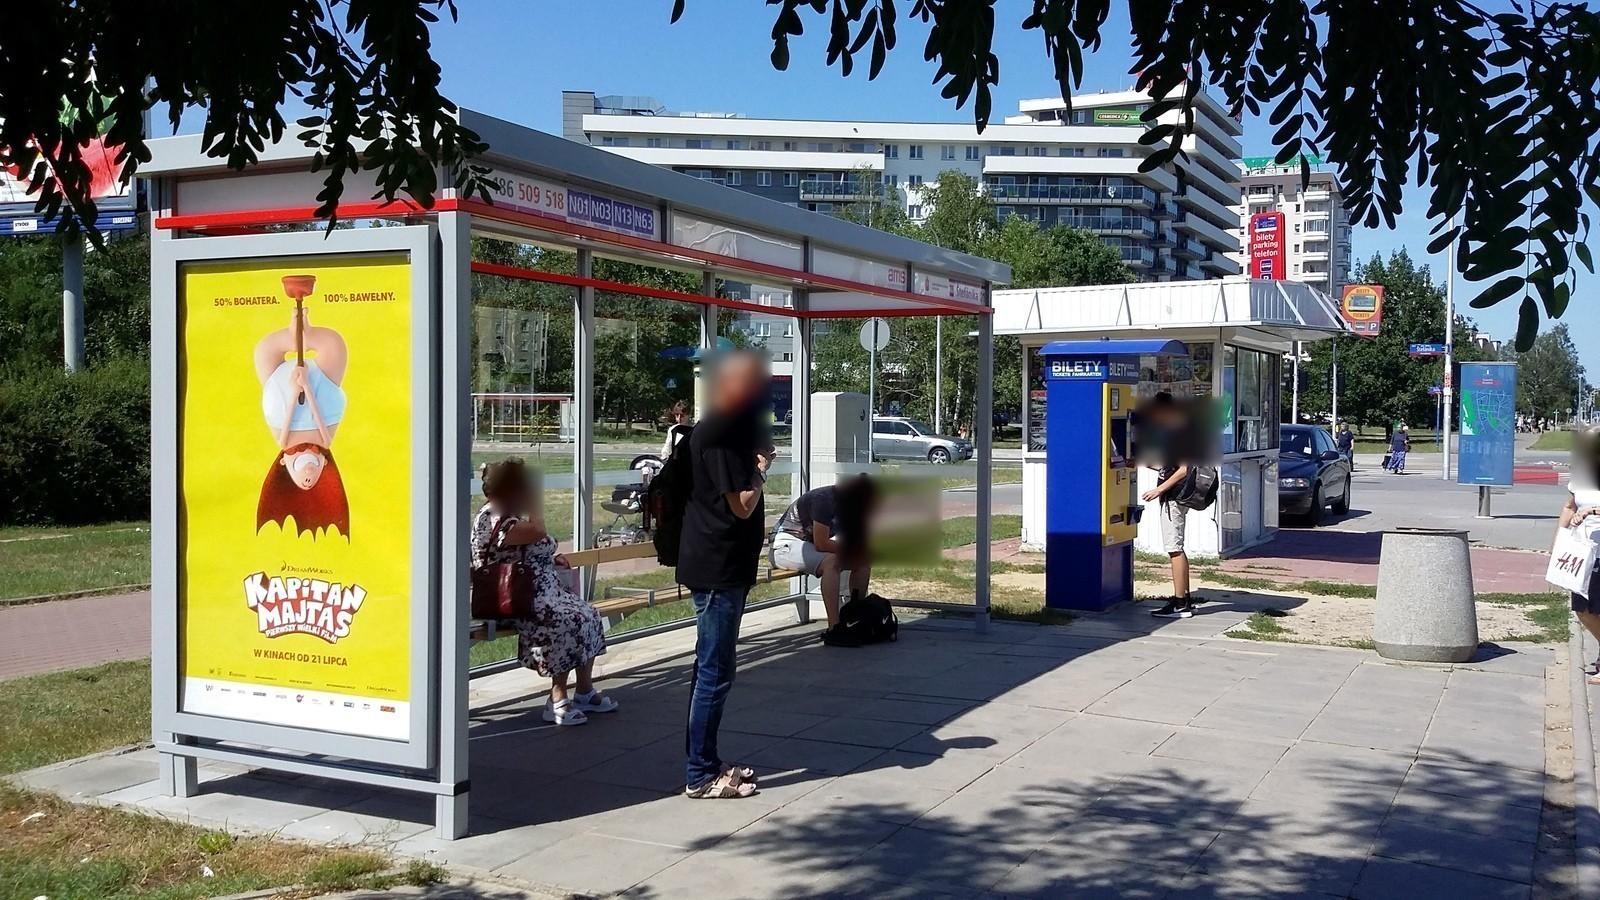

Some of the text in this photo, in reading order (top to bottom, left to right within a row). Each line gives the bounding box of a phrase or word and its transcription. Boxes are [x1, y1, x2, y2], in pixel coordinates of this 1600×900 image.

[518, 183, 541, 204] 509
[545, 190, 564, 210] 518
[569, 196, 653, 231] N01 N03 N13 N63
[1253, 241, 1278, 250] parking
[1255, 233, 1275, 242] bilety
[887, 268, 905, 284] ams
[214, 291, 395, 307] 50% BOHATERA. 100% BAWEŁNY.
[1052, 361, 1102, 372] BILETY
[1109, 362, 1127, 376] BILETY
[1554, 552, 1584, 577] H&M
[257, 600, 353, 638] MAJTAS
[254, 649, 347, 666] W KINACH OD 21 LIPCA
